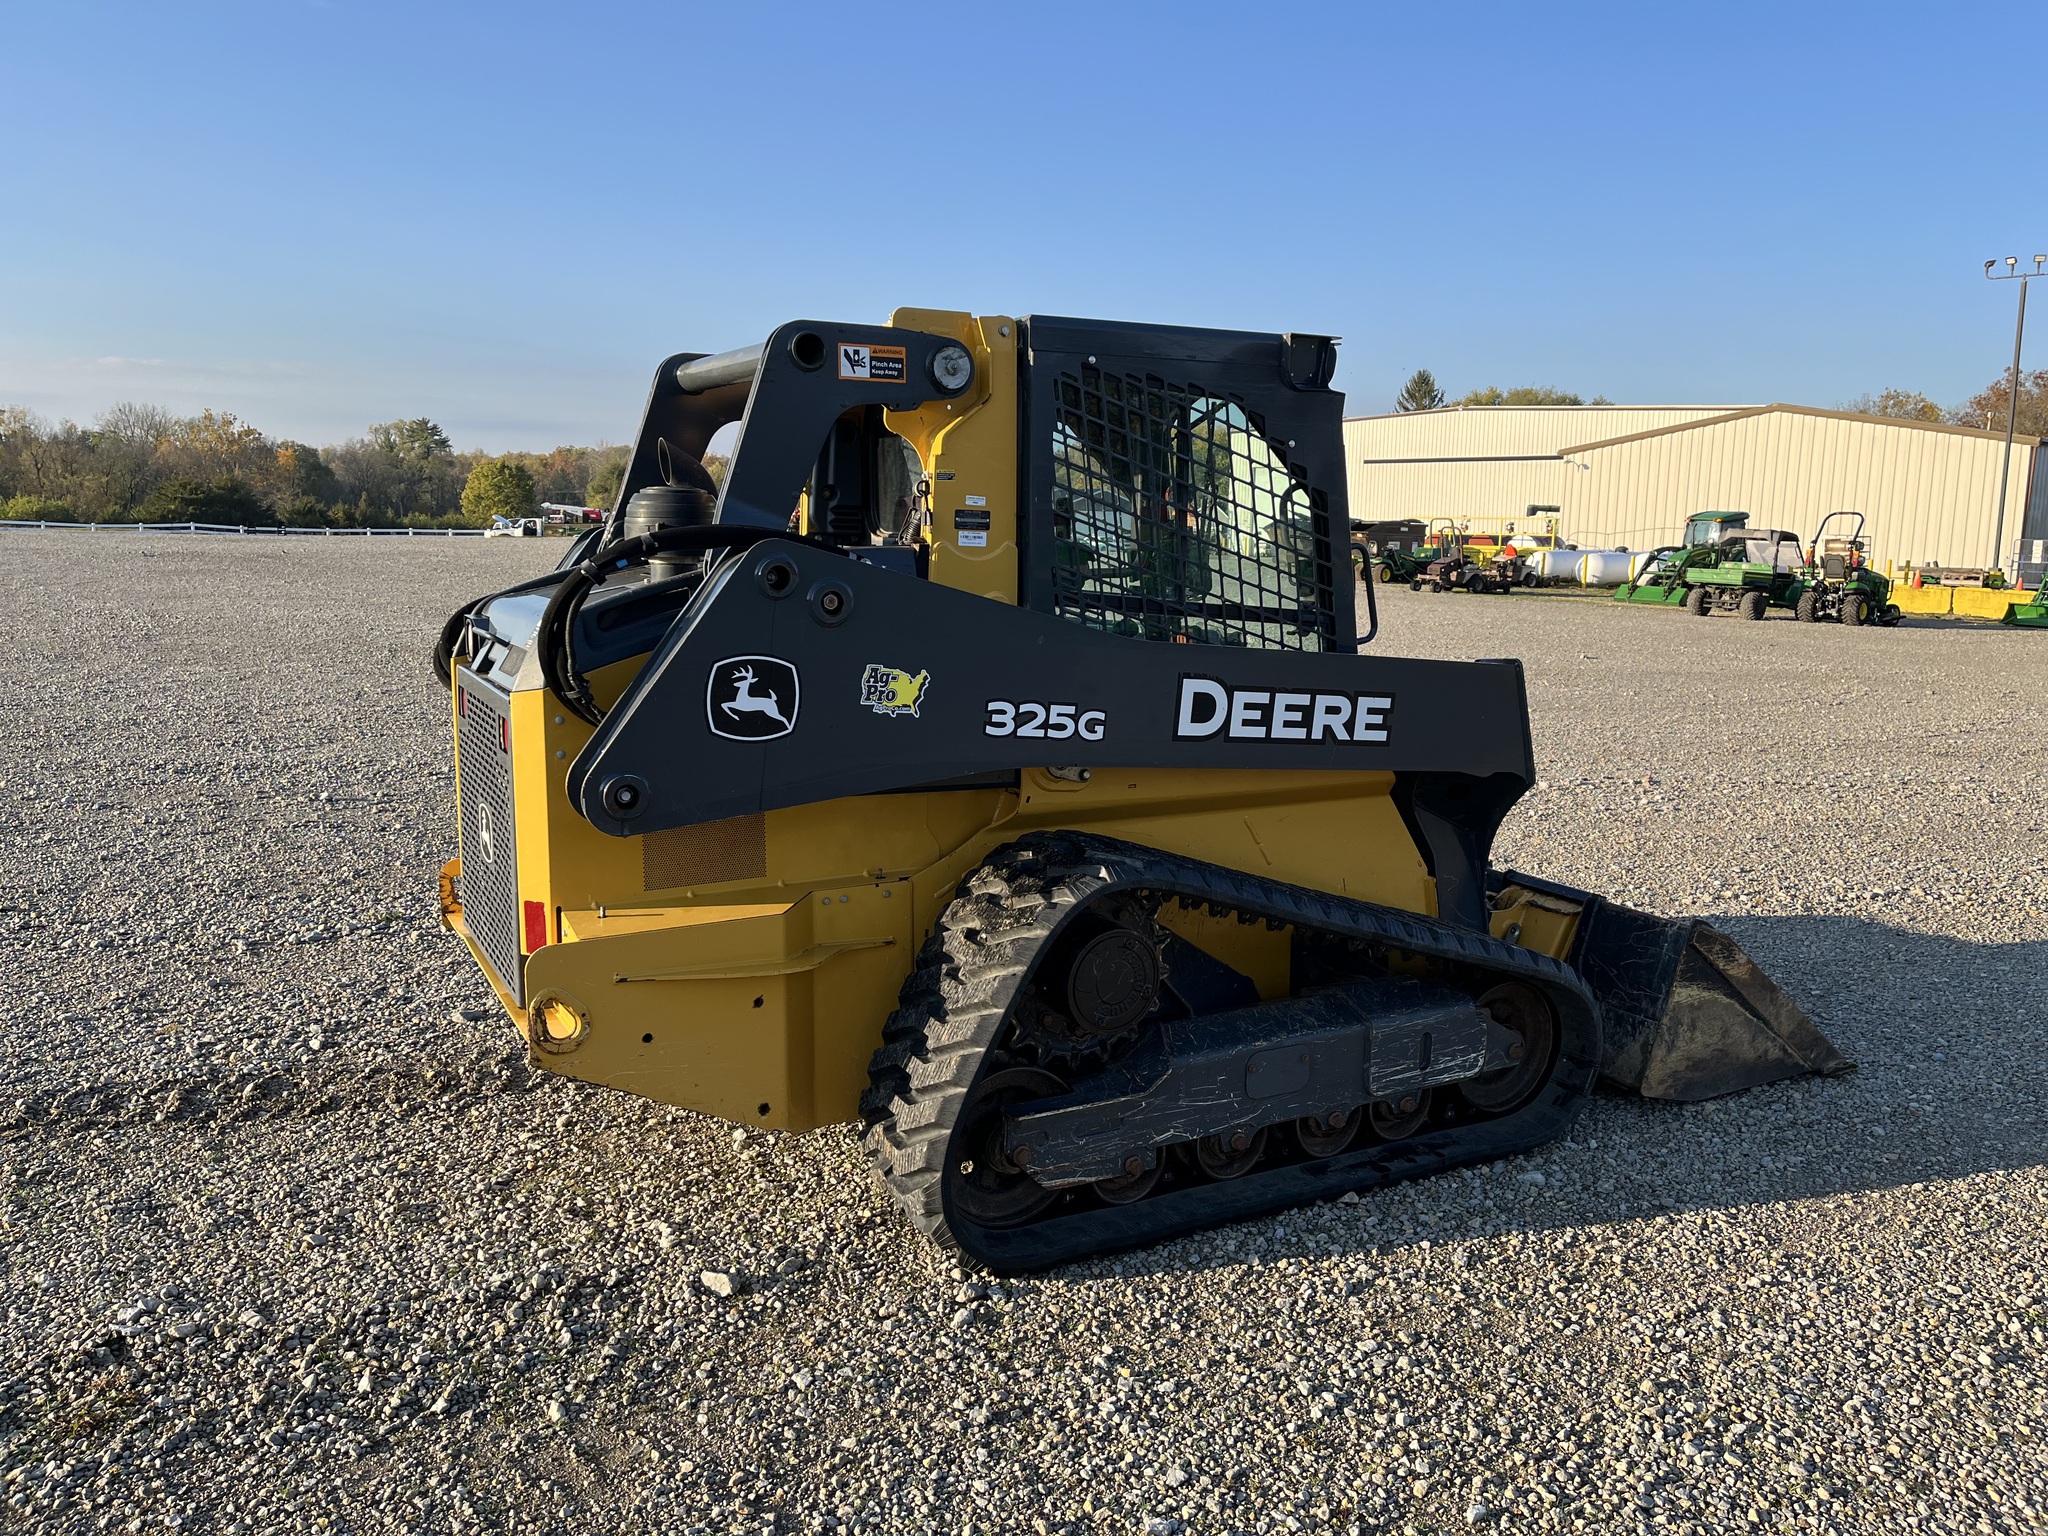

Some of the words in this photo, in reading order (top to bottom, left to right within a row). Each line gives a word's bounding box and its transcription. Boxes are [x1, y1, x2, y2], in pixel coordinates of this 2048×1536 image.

[864, 685, 896, 702] Pro
[1177, 678, 1392, 742] DEERE
[985, 701, 1106, 740] 325G
